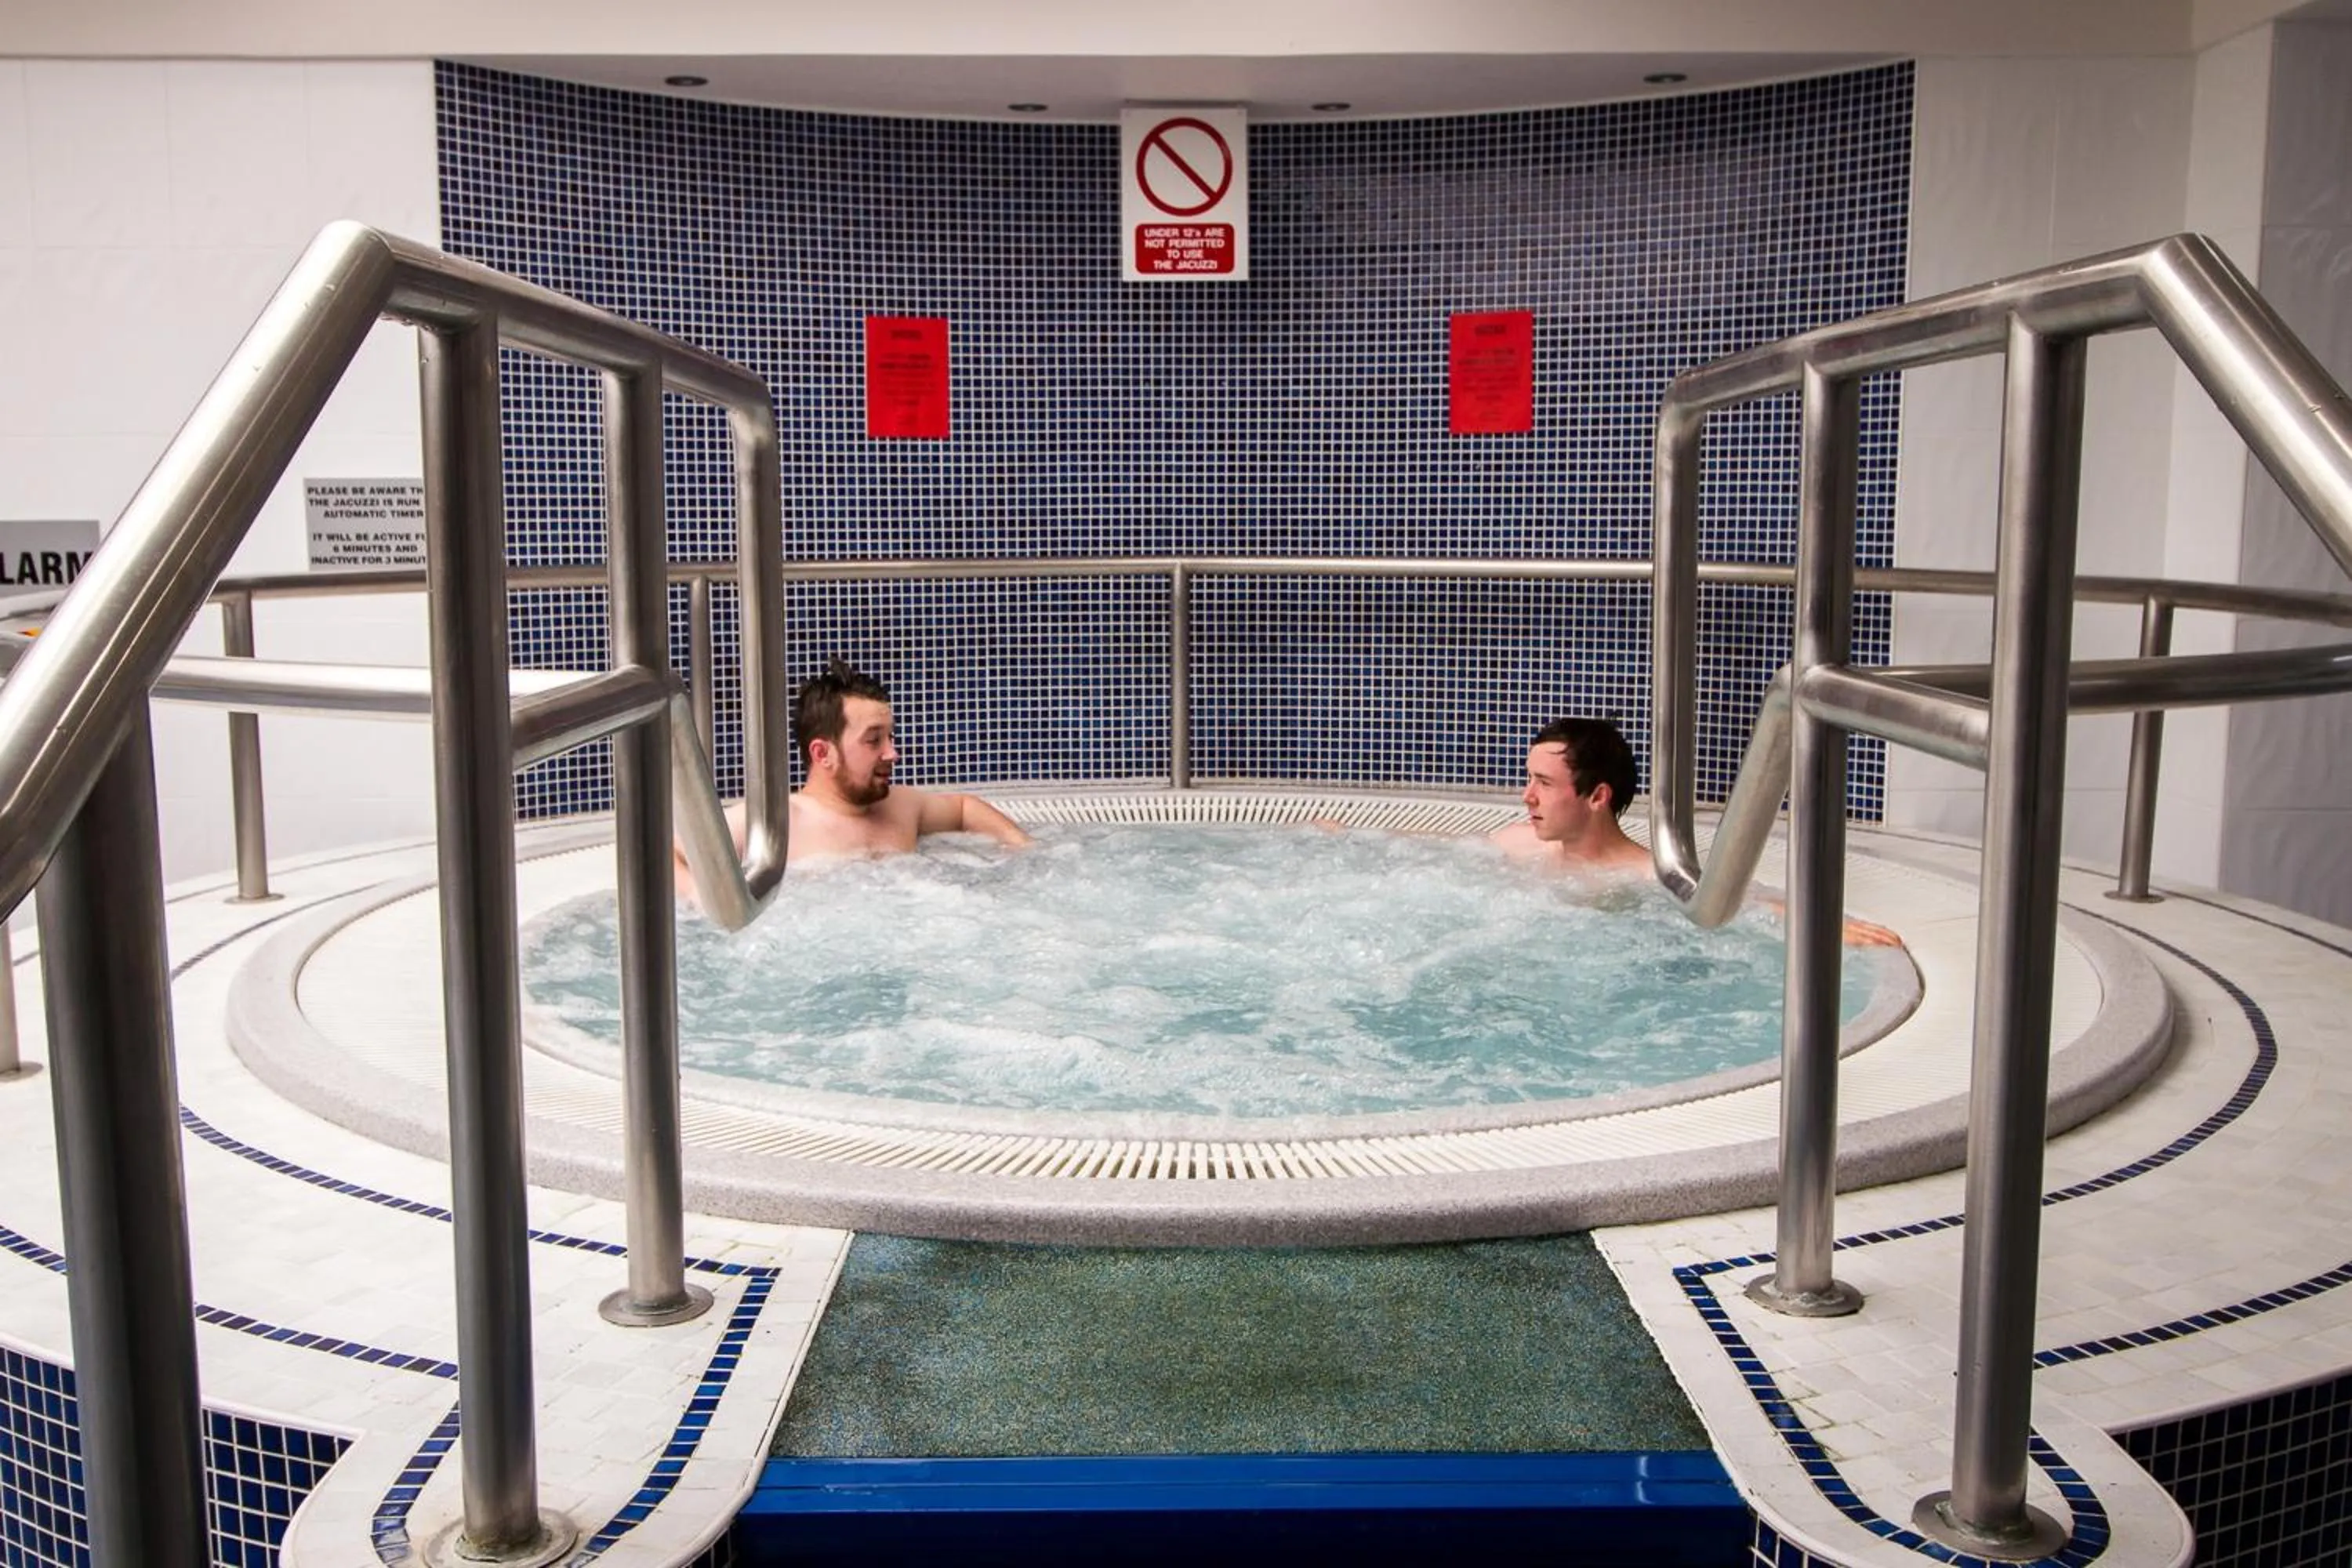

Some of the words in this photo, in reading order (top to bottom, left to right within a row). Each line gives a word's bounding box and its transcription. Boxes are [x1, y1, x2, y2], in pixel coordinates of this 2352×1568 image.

[1144, 227, 1179, 238] UNDER
[1204, 227, 1225, 237] ARE
[1144, 238, 1165, 249] NOT
[1168, 238, 1225, 249] PERMITTED
[1167, 249, 1181, 259] TO
[1182, 249, 1204, 259] USE
[1153, 260, 1173, 270] THE
[1177, 260, 1218, 270] JACUZZI
[307, 486, 347, 495] PLEASE
[351, 486, 365, 495] BE
[369, 486, 406, 495] AWARE
[309, 498, 328, 506] THE
[332, 498, 379, 506] JACUZZI
[383, 498, 394, 506] IS
[397, 498, 420, 506] RUN
[324, 510, 387, 518] AUTOMATIC
[390, 510, 424, 518] TIMER
[313, 532, 322, 541] IT
[326, 532, 352, 541] WILL
[355, 532, 368, 541] BE
[372, 532, 412, 541] ACTIVE
[395, 544, 418, 553] AND
[311, 556, 359, 564] INACTIVE
[361, 556, 383, 564] FOR
[385, 556, 391, 564] 3
